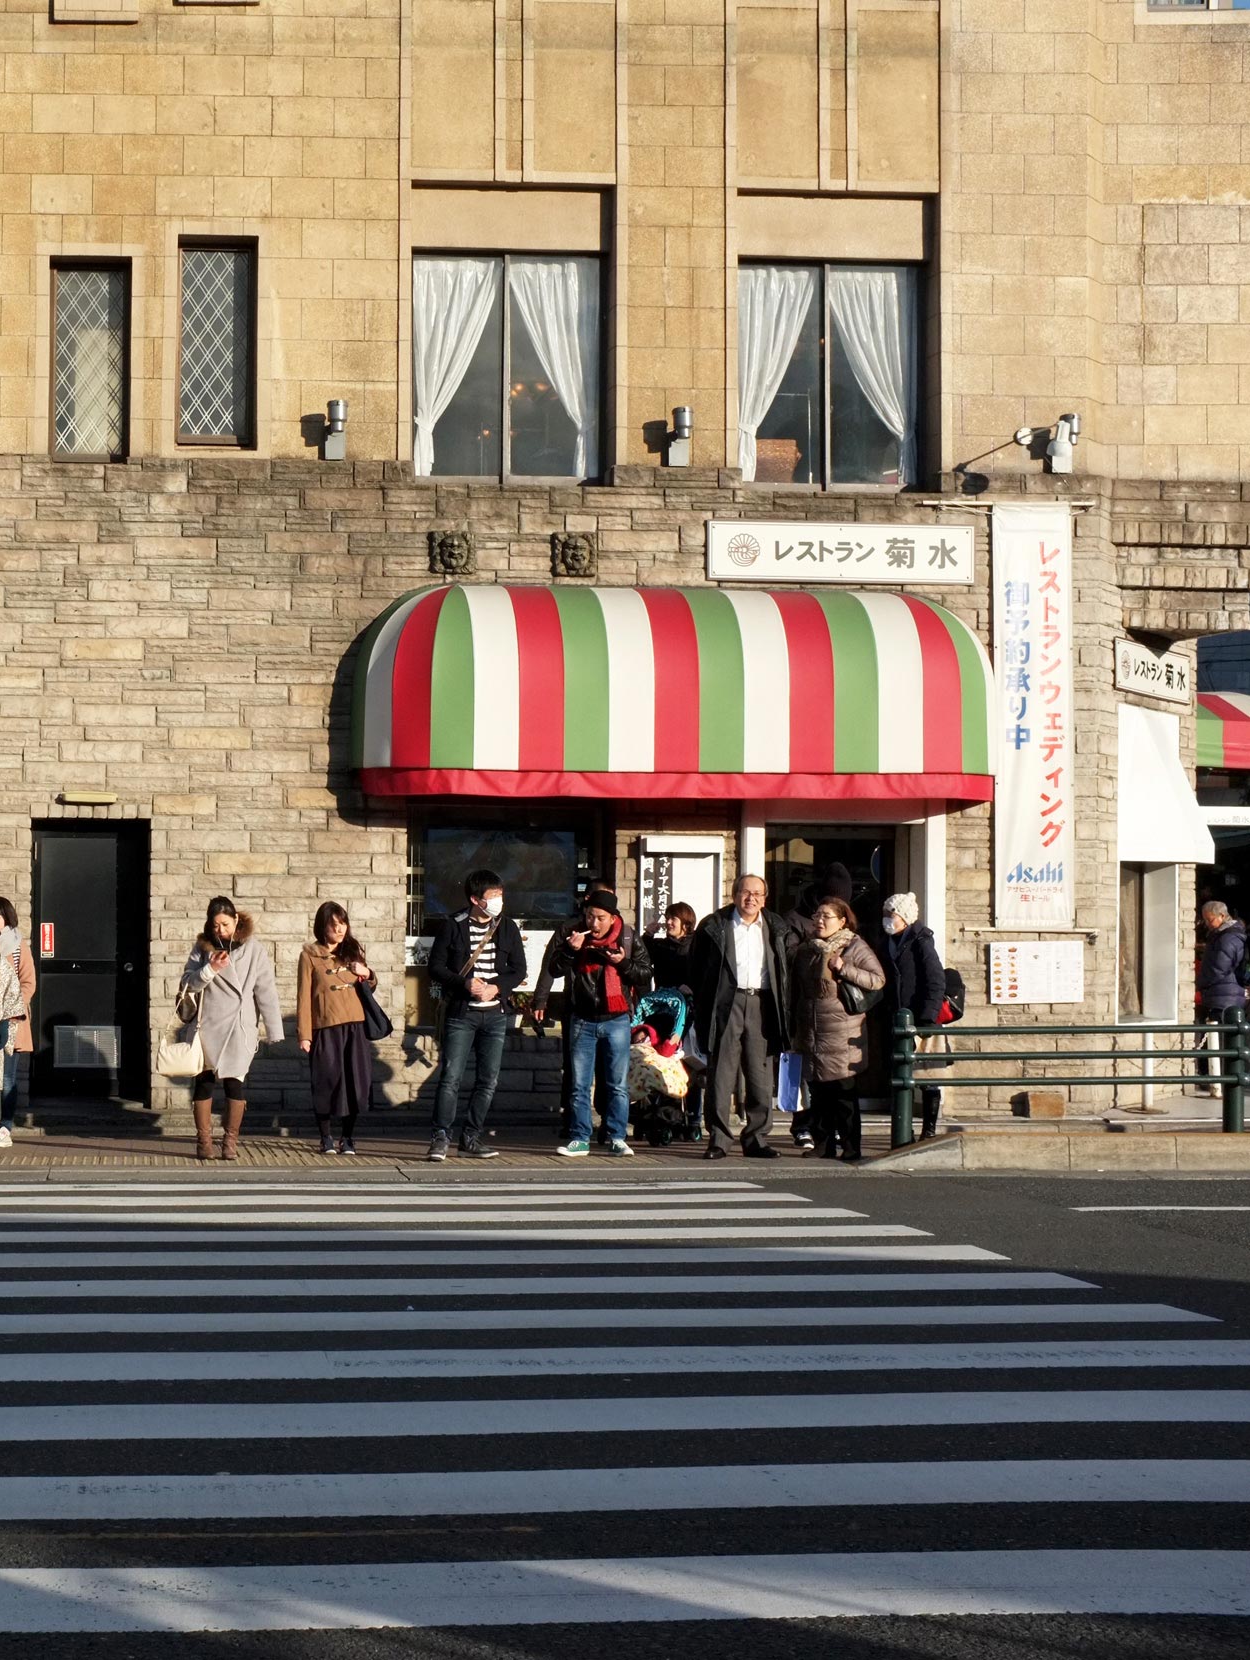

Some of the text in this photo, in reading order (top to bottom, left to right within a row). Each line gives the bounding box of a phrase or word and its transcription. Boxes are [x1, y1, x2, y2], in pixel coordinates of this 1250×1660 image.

[1004, 580, 1031, 750] 御予約承り中
[1038, 541, 1066, 848] レストランウェディング
[1007, 861, 1063, 883] Asahi
